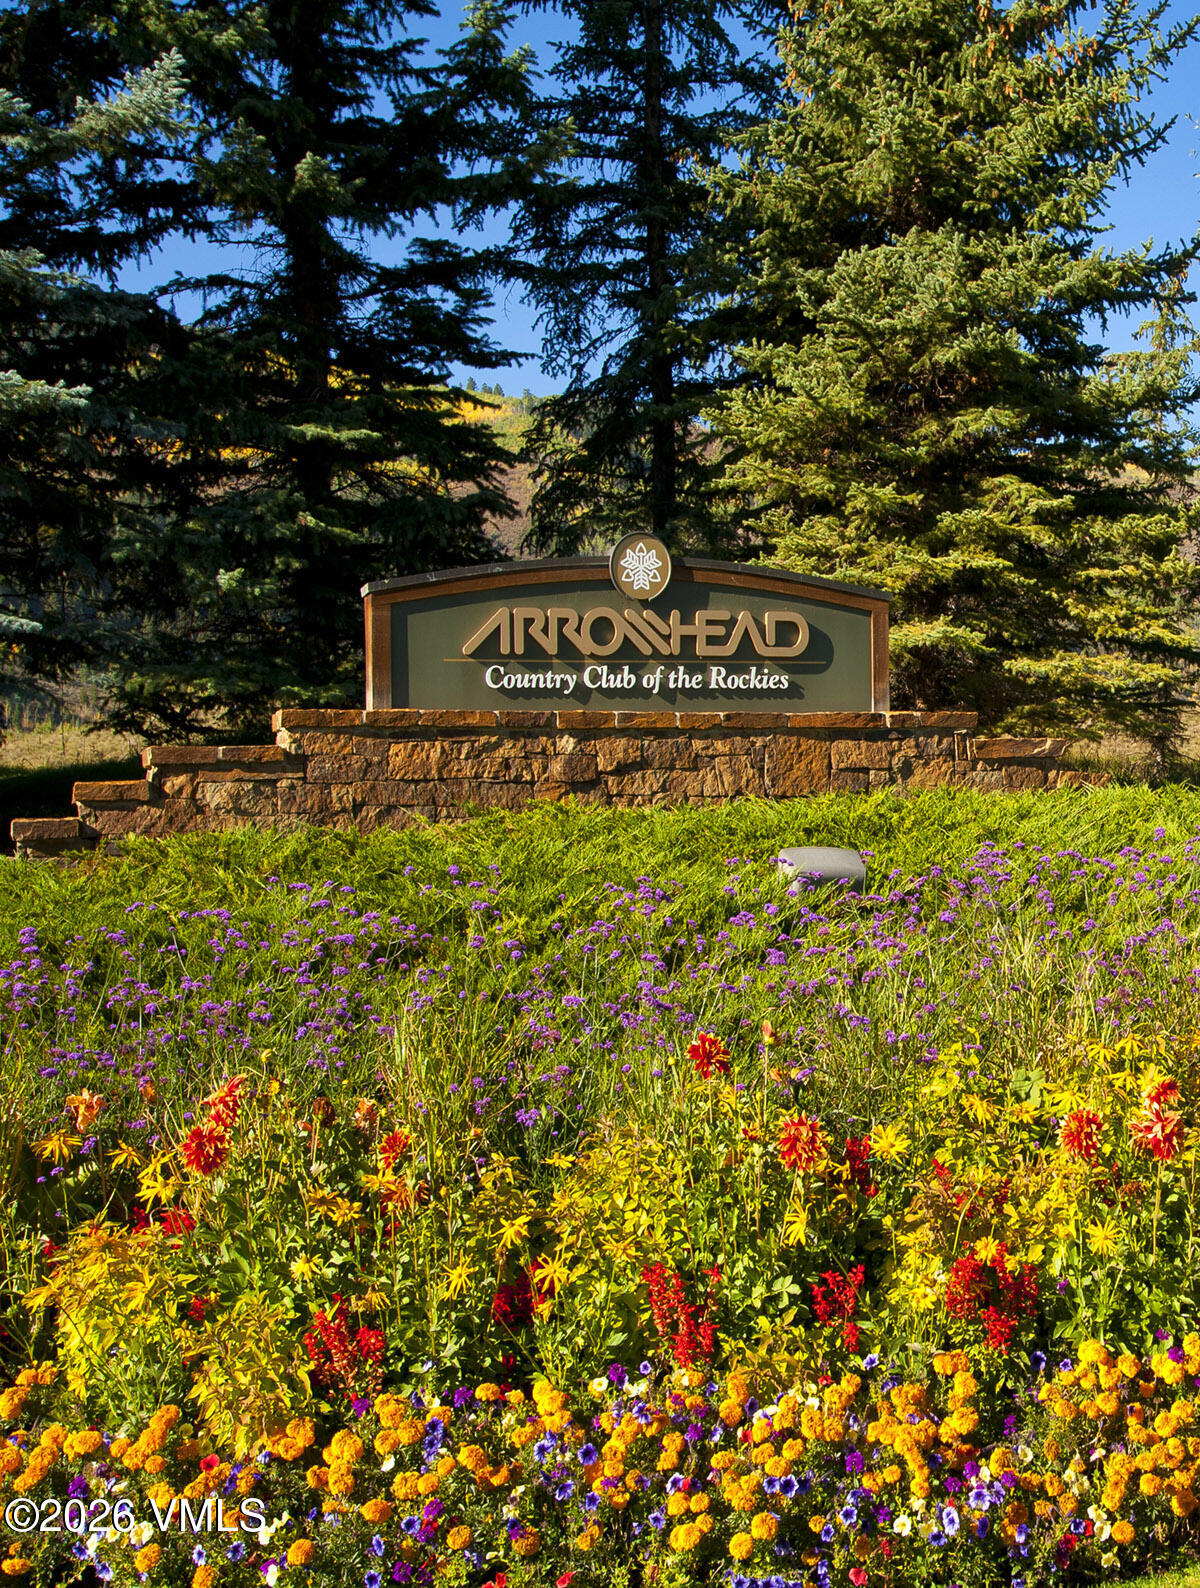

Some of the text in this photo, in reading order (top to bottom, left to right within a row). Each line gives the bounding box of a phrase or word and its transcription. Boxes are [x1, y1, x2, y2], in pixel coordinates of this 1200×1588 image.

[462, 607, 810, 657] ARROWHEAD
[485, 665, 789, 694] Country Club of the Rockies
